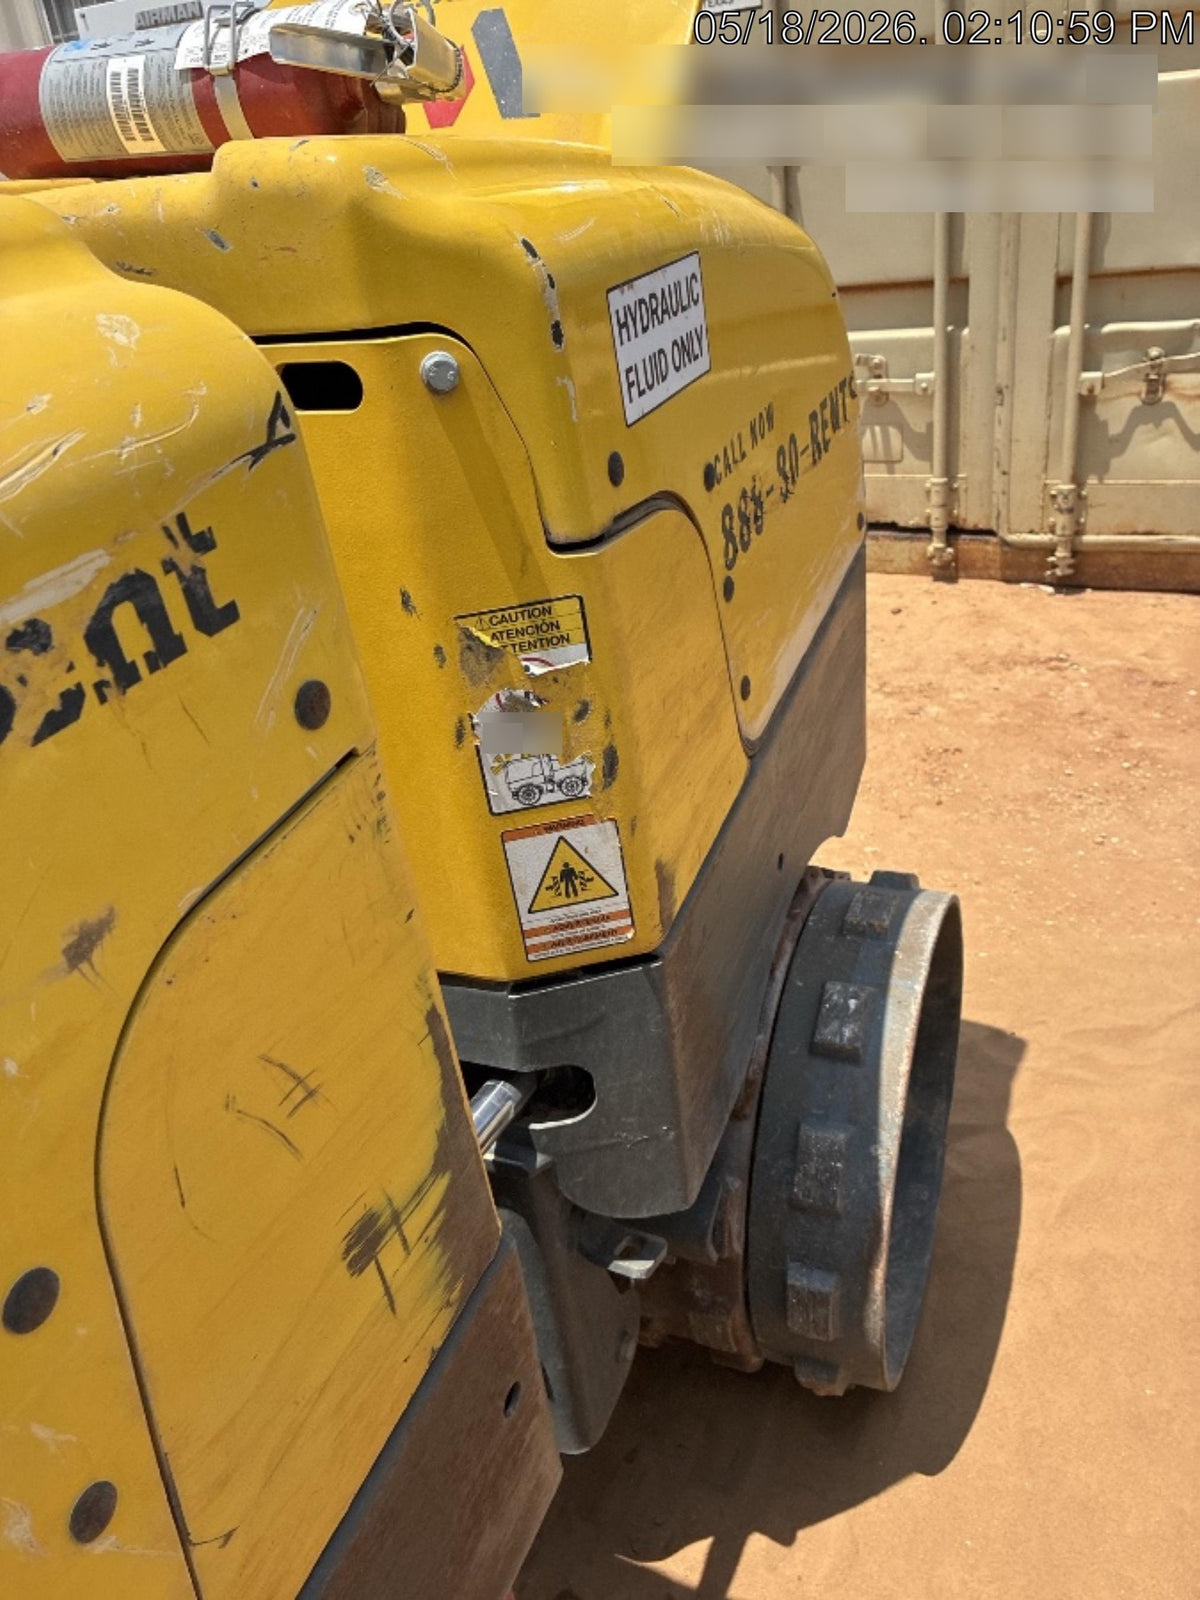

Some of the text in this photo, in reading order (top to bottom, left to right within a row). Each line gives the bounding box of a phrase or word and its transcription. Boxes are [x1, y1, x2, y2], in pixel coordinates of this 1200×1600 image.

[135, 1, 204, 30] AIRMAN
[615, 272, 700, 346] HYDRAULIC
[625, 325, 703, 403] FLUID ONLY
[713, 402, 774, 485] CALL NOW
[489, 606, 552, 627] CAUTION
[490, 619, 561, 642] ATENCIÓN
[503, 633, 570, 654] TENTION
